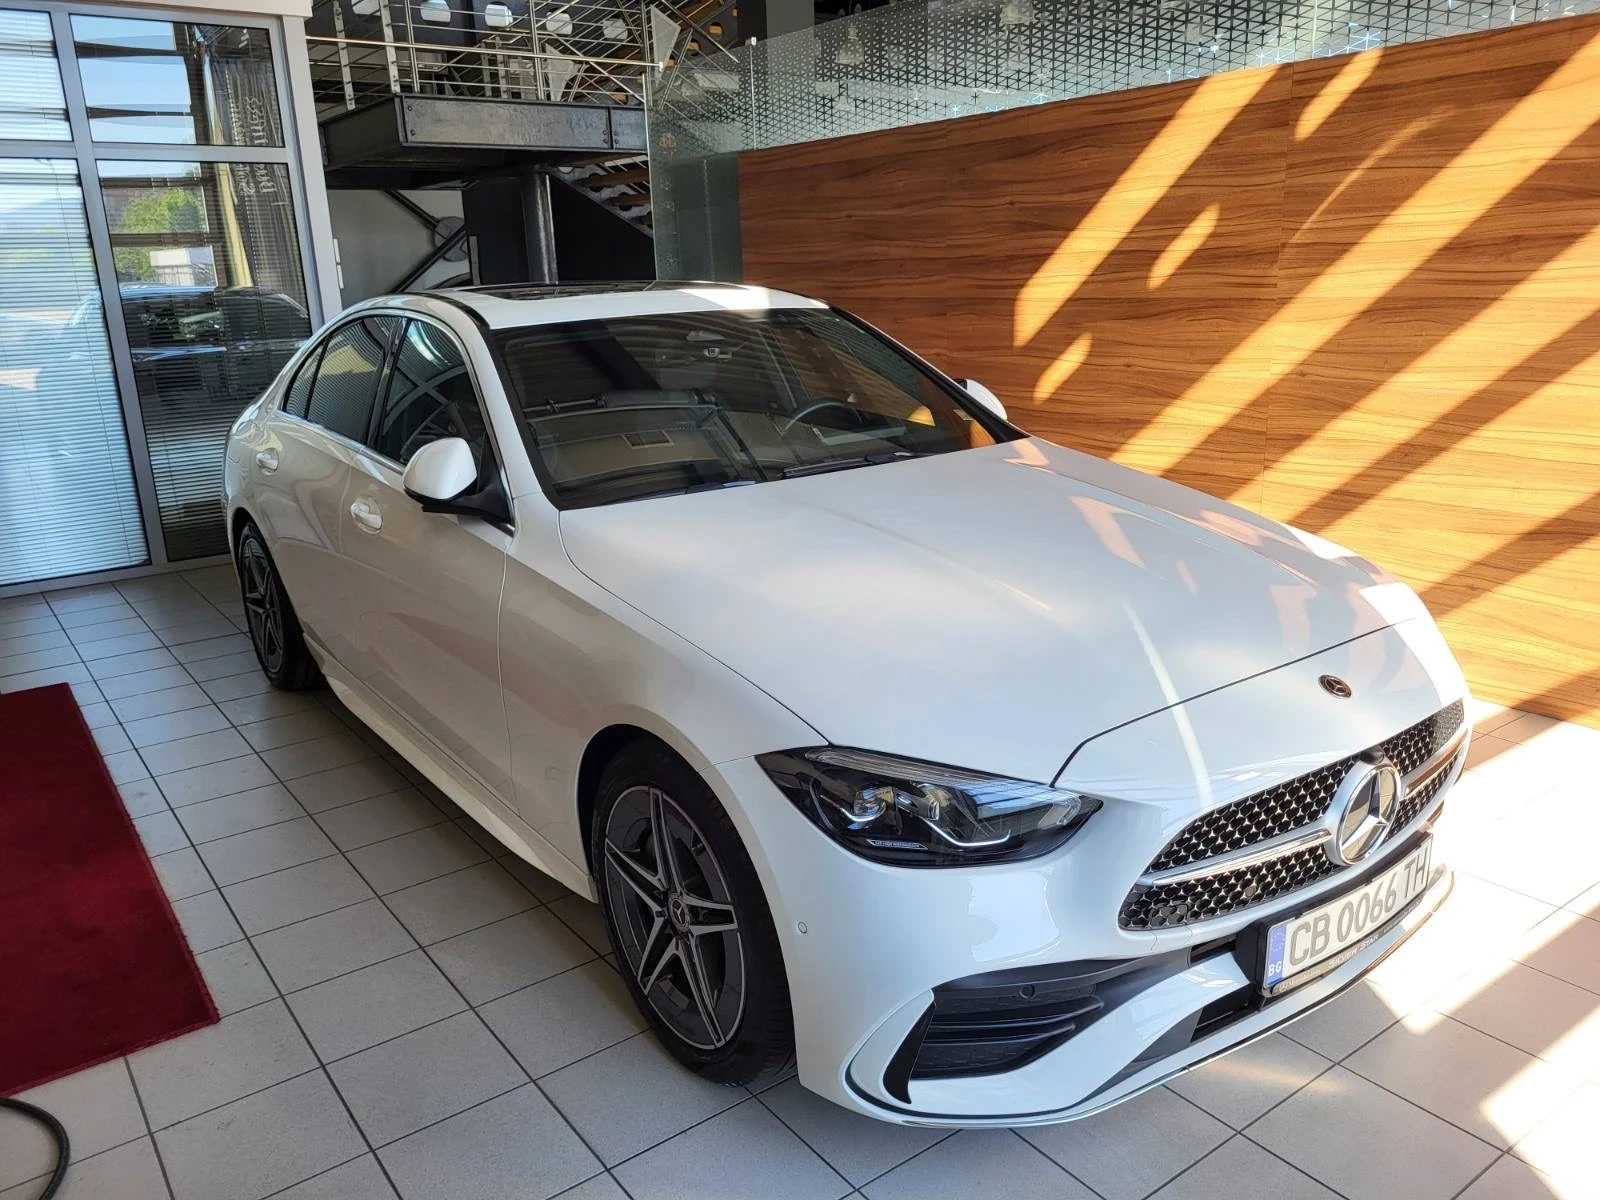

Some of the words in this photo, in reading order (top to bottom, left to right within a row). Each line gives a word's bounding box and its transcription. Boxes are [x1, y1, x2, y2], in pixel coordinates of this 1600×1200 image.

[1290, 914, 1331, 966] CB
[1337, 873, 1397, 943] 0066
[1404, 846, 1428, 899] TH
[1268, 961, 1282, 977] BG
